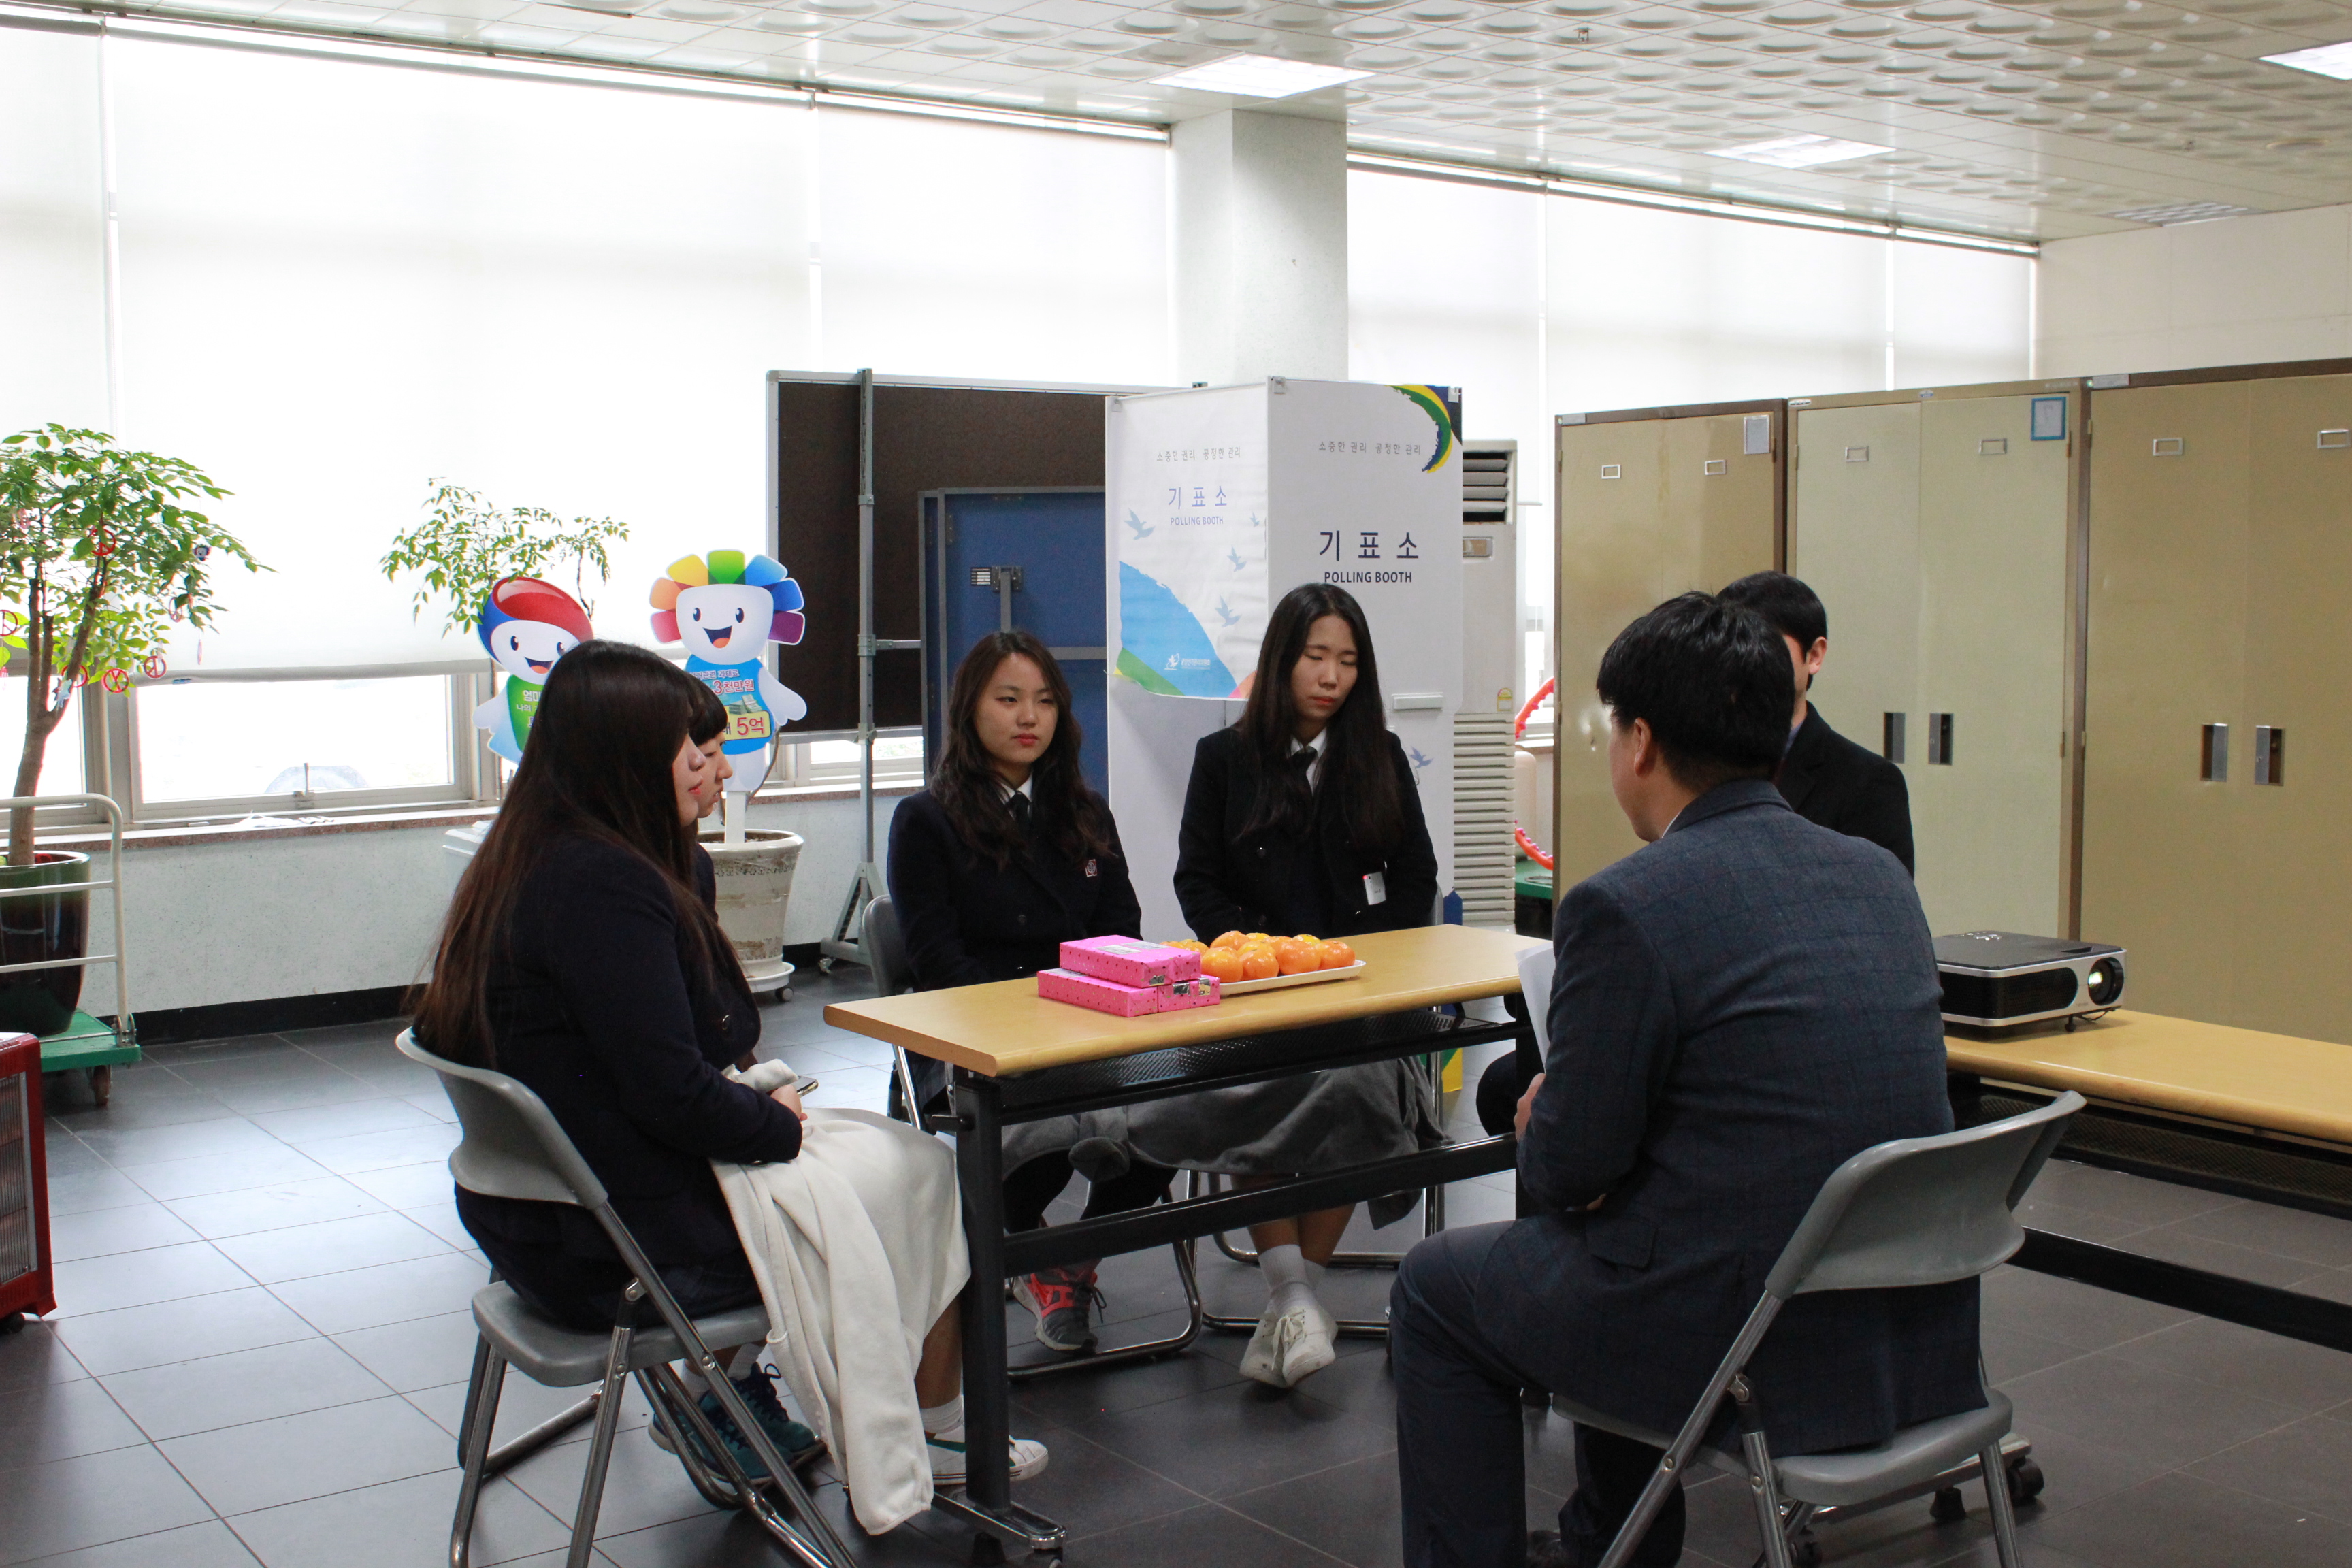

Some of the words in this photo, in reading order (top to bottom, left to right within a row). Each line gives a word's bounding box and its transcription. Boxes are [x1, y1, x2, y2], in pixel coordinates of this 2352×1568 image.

[1156, 450, 1178, 462] 소중한
[1181, 449, 1196, 461] 권리
[1203, 448, 1224, 460] 공정한
[1228, 446, 1241, 459] 관리
[1318, 441, 1345, 453] 소중한
[1350, 442, 1367, 453] 권리
[1375, 443, 1401, 455] 공정한
[1405, 444, 1421, 455] 관리
[1168, 485, 1227, 510] 기표소
[1170, 517, 1201, 525] POLLING
[1203, 516, 1224, 525] BOOTH
[1319, 530, 1419, 561] 기표소
[1324, 572, 1371, 583] POLLING
[1375, 572, 1412, 583] BOOTH
[717, 669, 740, 679] 과태료
[713, 679, 755, 695] 3천만원
[736, 717, 764, 736] 5억
